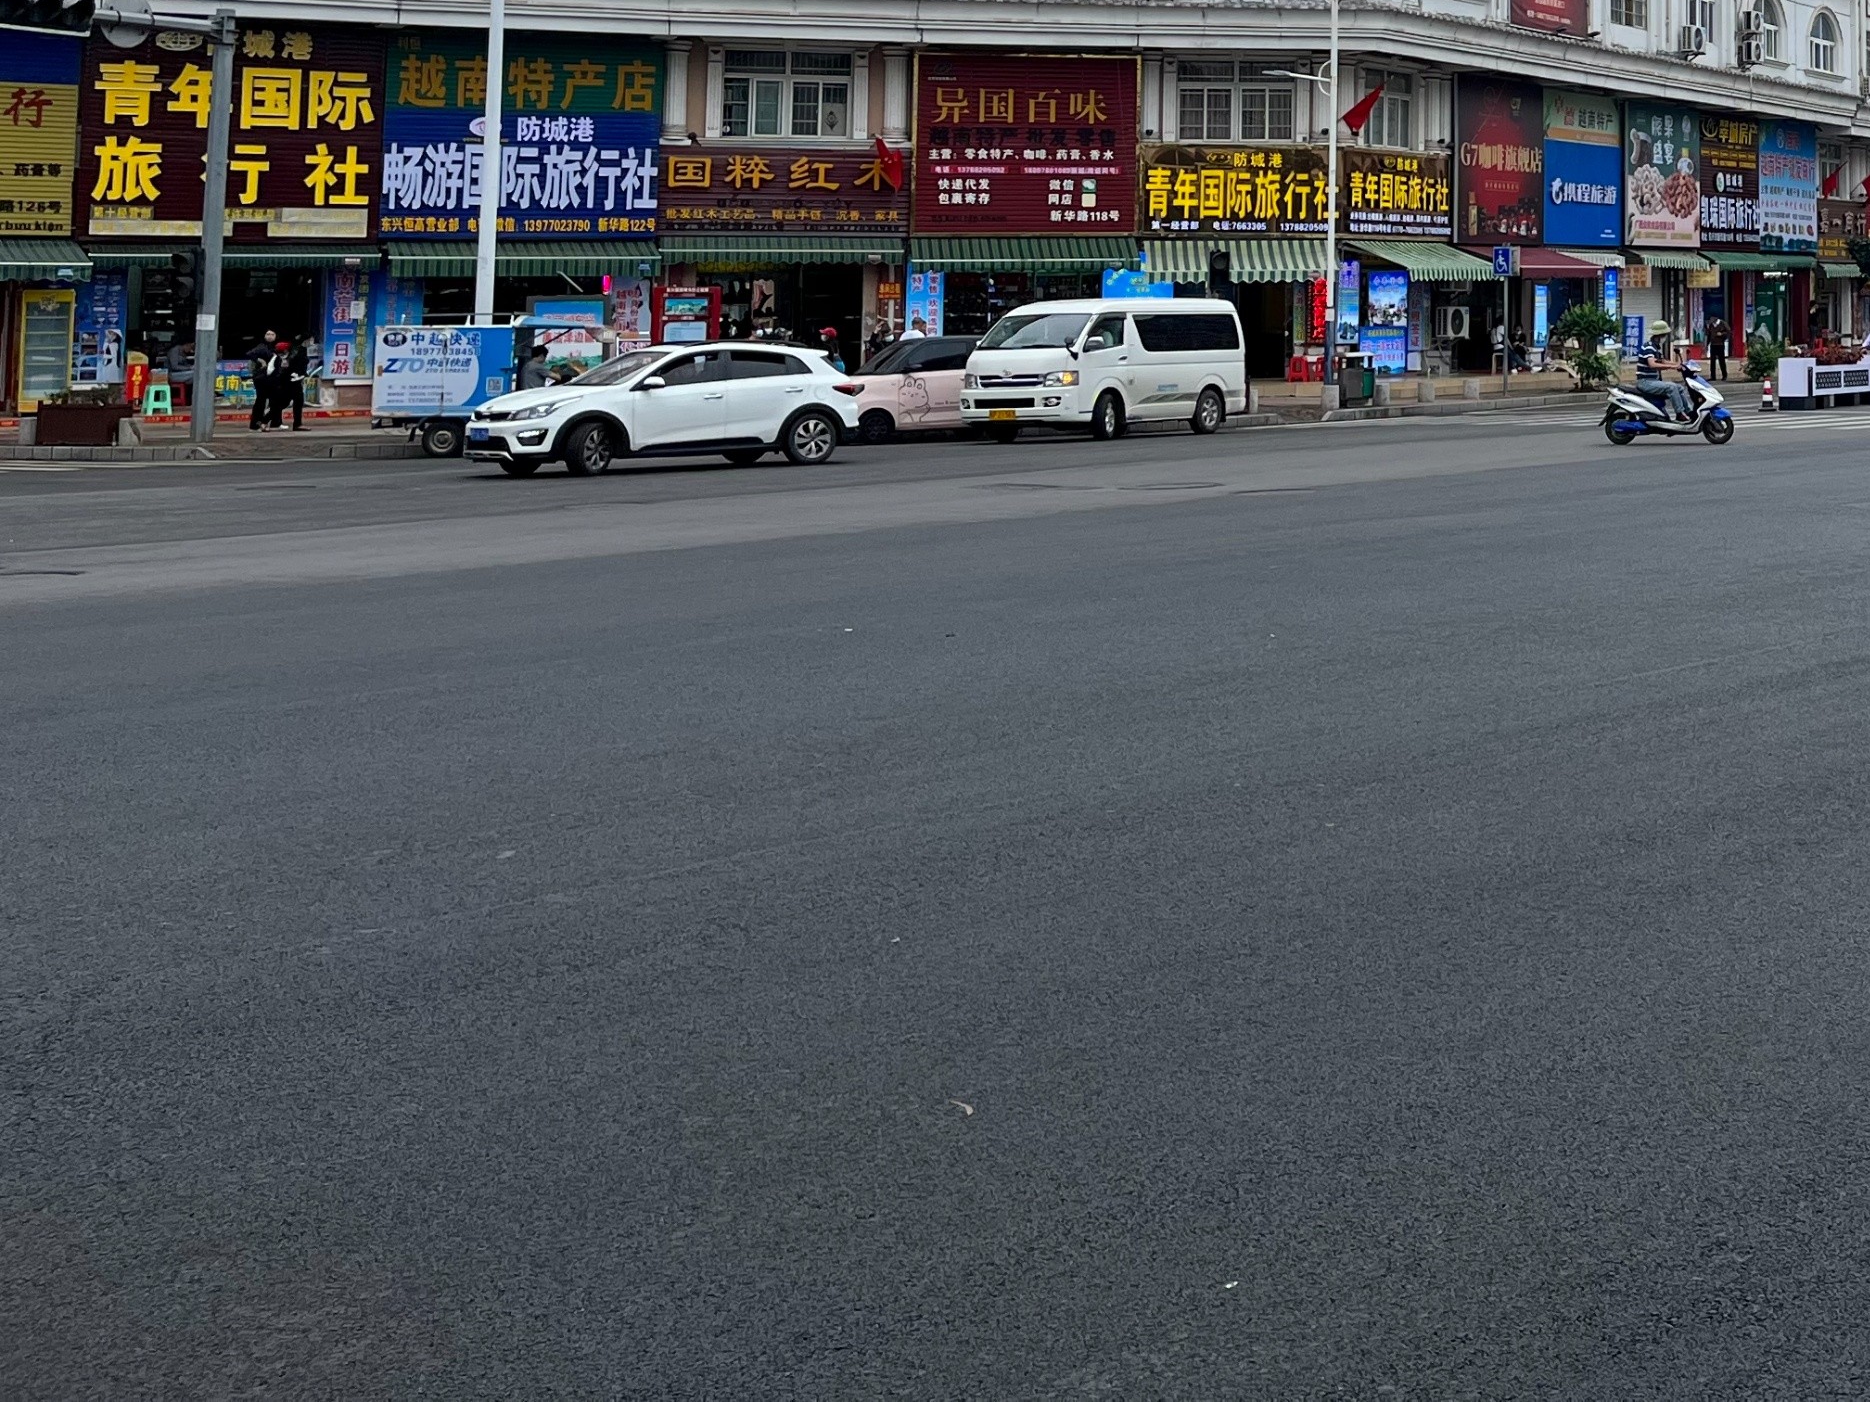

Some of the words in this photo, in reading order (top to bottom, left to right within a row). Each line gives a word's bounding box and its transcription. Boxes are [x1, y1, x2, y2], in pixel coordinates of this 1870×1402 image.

[207, 29, 314, 61] 城港
[94, 60, 375, 131] 青年国际
[397, 54, 657, 112] 越南特产店
[3, 86, 54, 129] 行
[931, 87, 1108, 124] 异国百味
[516, 116, 595, 143] 防城港
[1233, 152, 1283, 169] 防城港
[1460, 141, 1543, 174] G7咖啡旗舰店
[382, 141, 659, 211] 畅游国际旅行社
[667, 155, 890, 191] 国粹红木
[937, 178, 990, 191] 快递代发
[1048, 178, 1075, 191] 微信
[937, 193, 991, 205] 包裹寄存
[1145, 166, 1340, 221] 青年国际旅行社
[1349, 170, 1449, 212] 青年国际旅行社
[1563, 182, 1617, 205] 携程旅游
[524, 219, 591, 232] 13977023790
[598, 218, 657, 233] 新华路122号
[1049, 210, 1120, 222] 新华路118号
[1151, 220, 1200, 231] 第一经营部
[1279, 222, 1330, 232] 1378820509
[383, 358, 425, 373] ZTO
